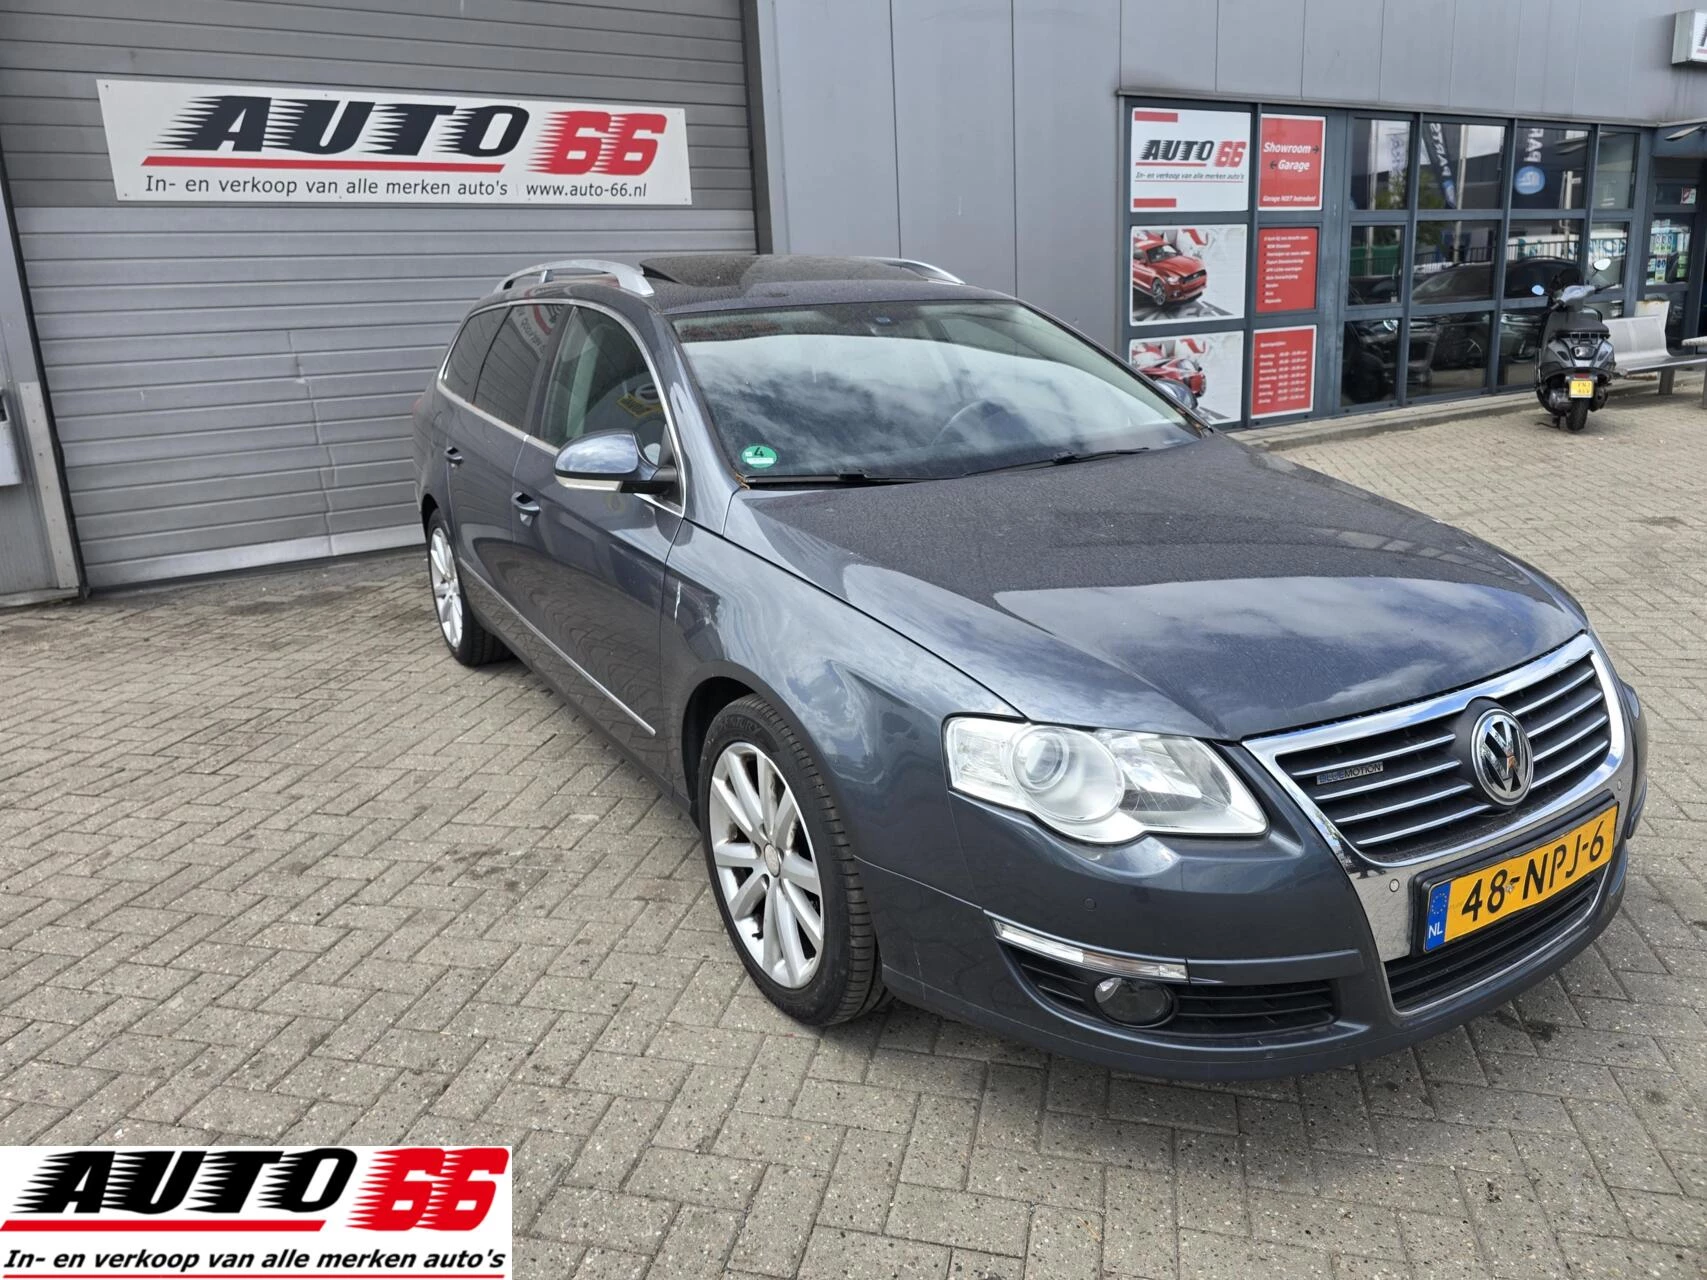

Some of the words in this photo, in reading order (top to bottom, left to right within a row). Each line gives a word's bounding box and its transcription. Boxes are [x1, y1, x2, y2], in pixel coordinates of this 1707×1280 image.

[148, 95, 530, 157] AUTO
[526, 110, 668, 176] 66
[1140, 139, 1215, 161] AUTO
[1214, 141, 1247, 168] 66
[1263, 141, 1312, 154] Showroom
[1278, 159, 1310, 173] Garage
[145, 175, 176, 191] In-
[185, 179, 209, 192] en
[219, 177, 298, 196] verkoop
[306, 180, 338, 194] van
[346, 178, 378, 194] alle
[386, 180, 451, 195] merken
[457, 181, 508, 196] auto's
[526, 183, 647, 197] www.auto-66.nl
[1318, 763, 1383, 784] BLUEMOTION
[1461, 820, 1605, 922] 48-NPJ-6
[1428, 923, 1444, 939] NL
